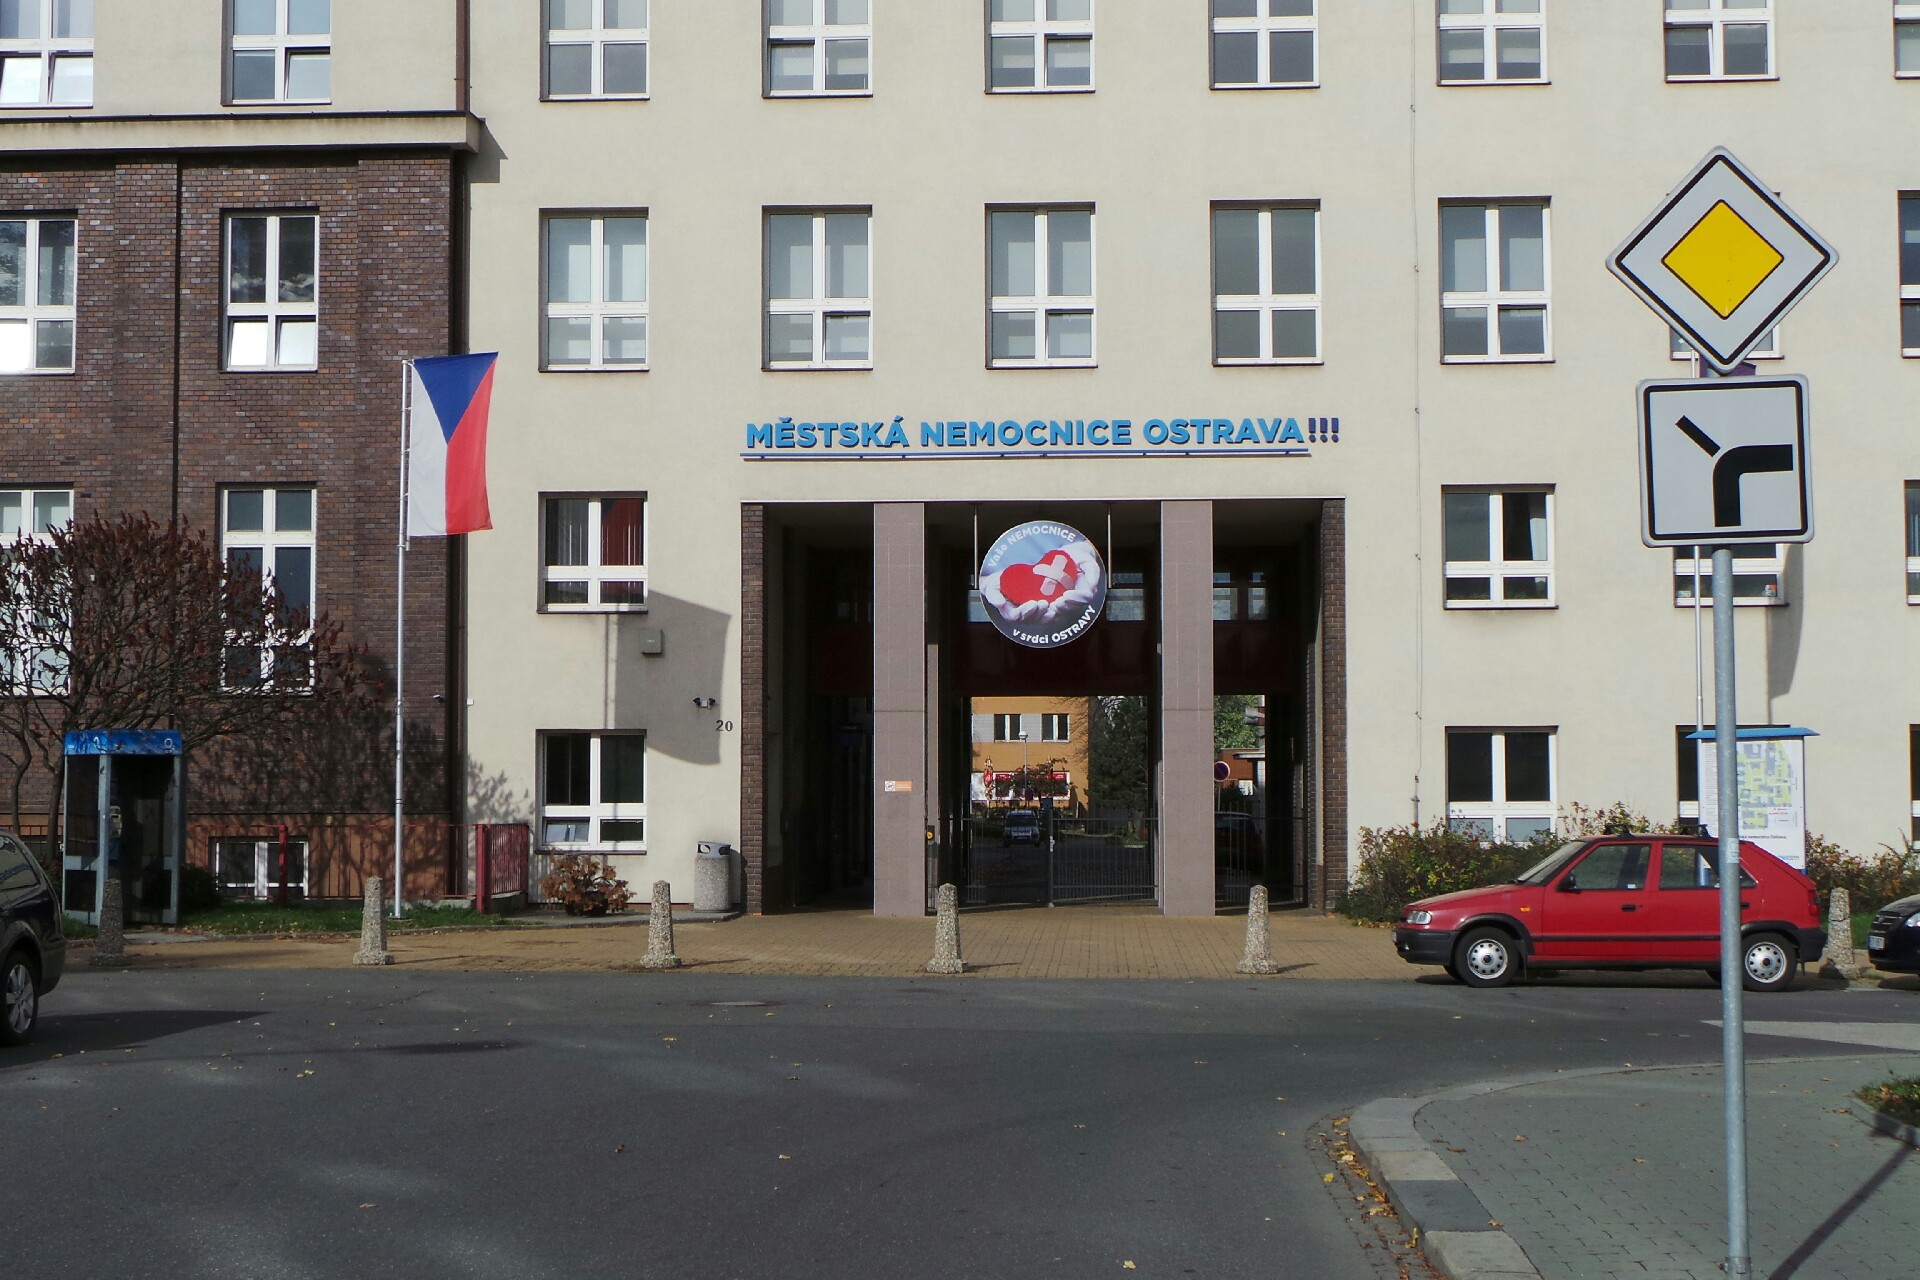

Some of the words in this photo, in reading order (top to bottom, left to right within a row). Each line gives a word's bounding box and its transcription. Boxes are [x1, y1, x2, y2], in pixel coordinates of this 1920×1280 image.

[746, 415, 908, 449] MĚSTSKÁ
[921, 419, 1134, 448] NEMOCNICE
[1007, 525, 1076, 544] NEMOCNICE
[1020, 632, 1049, 644] srdci
[1051, 604, 1096, 643] OSTRAVY
[715, 719, 733, 732] 20
